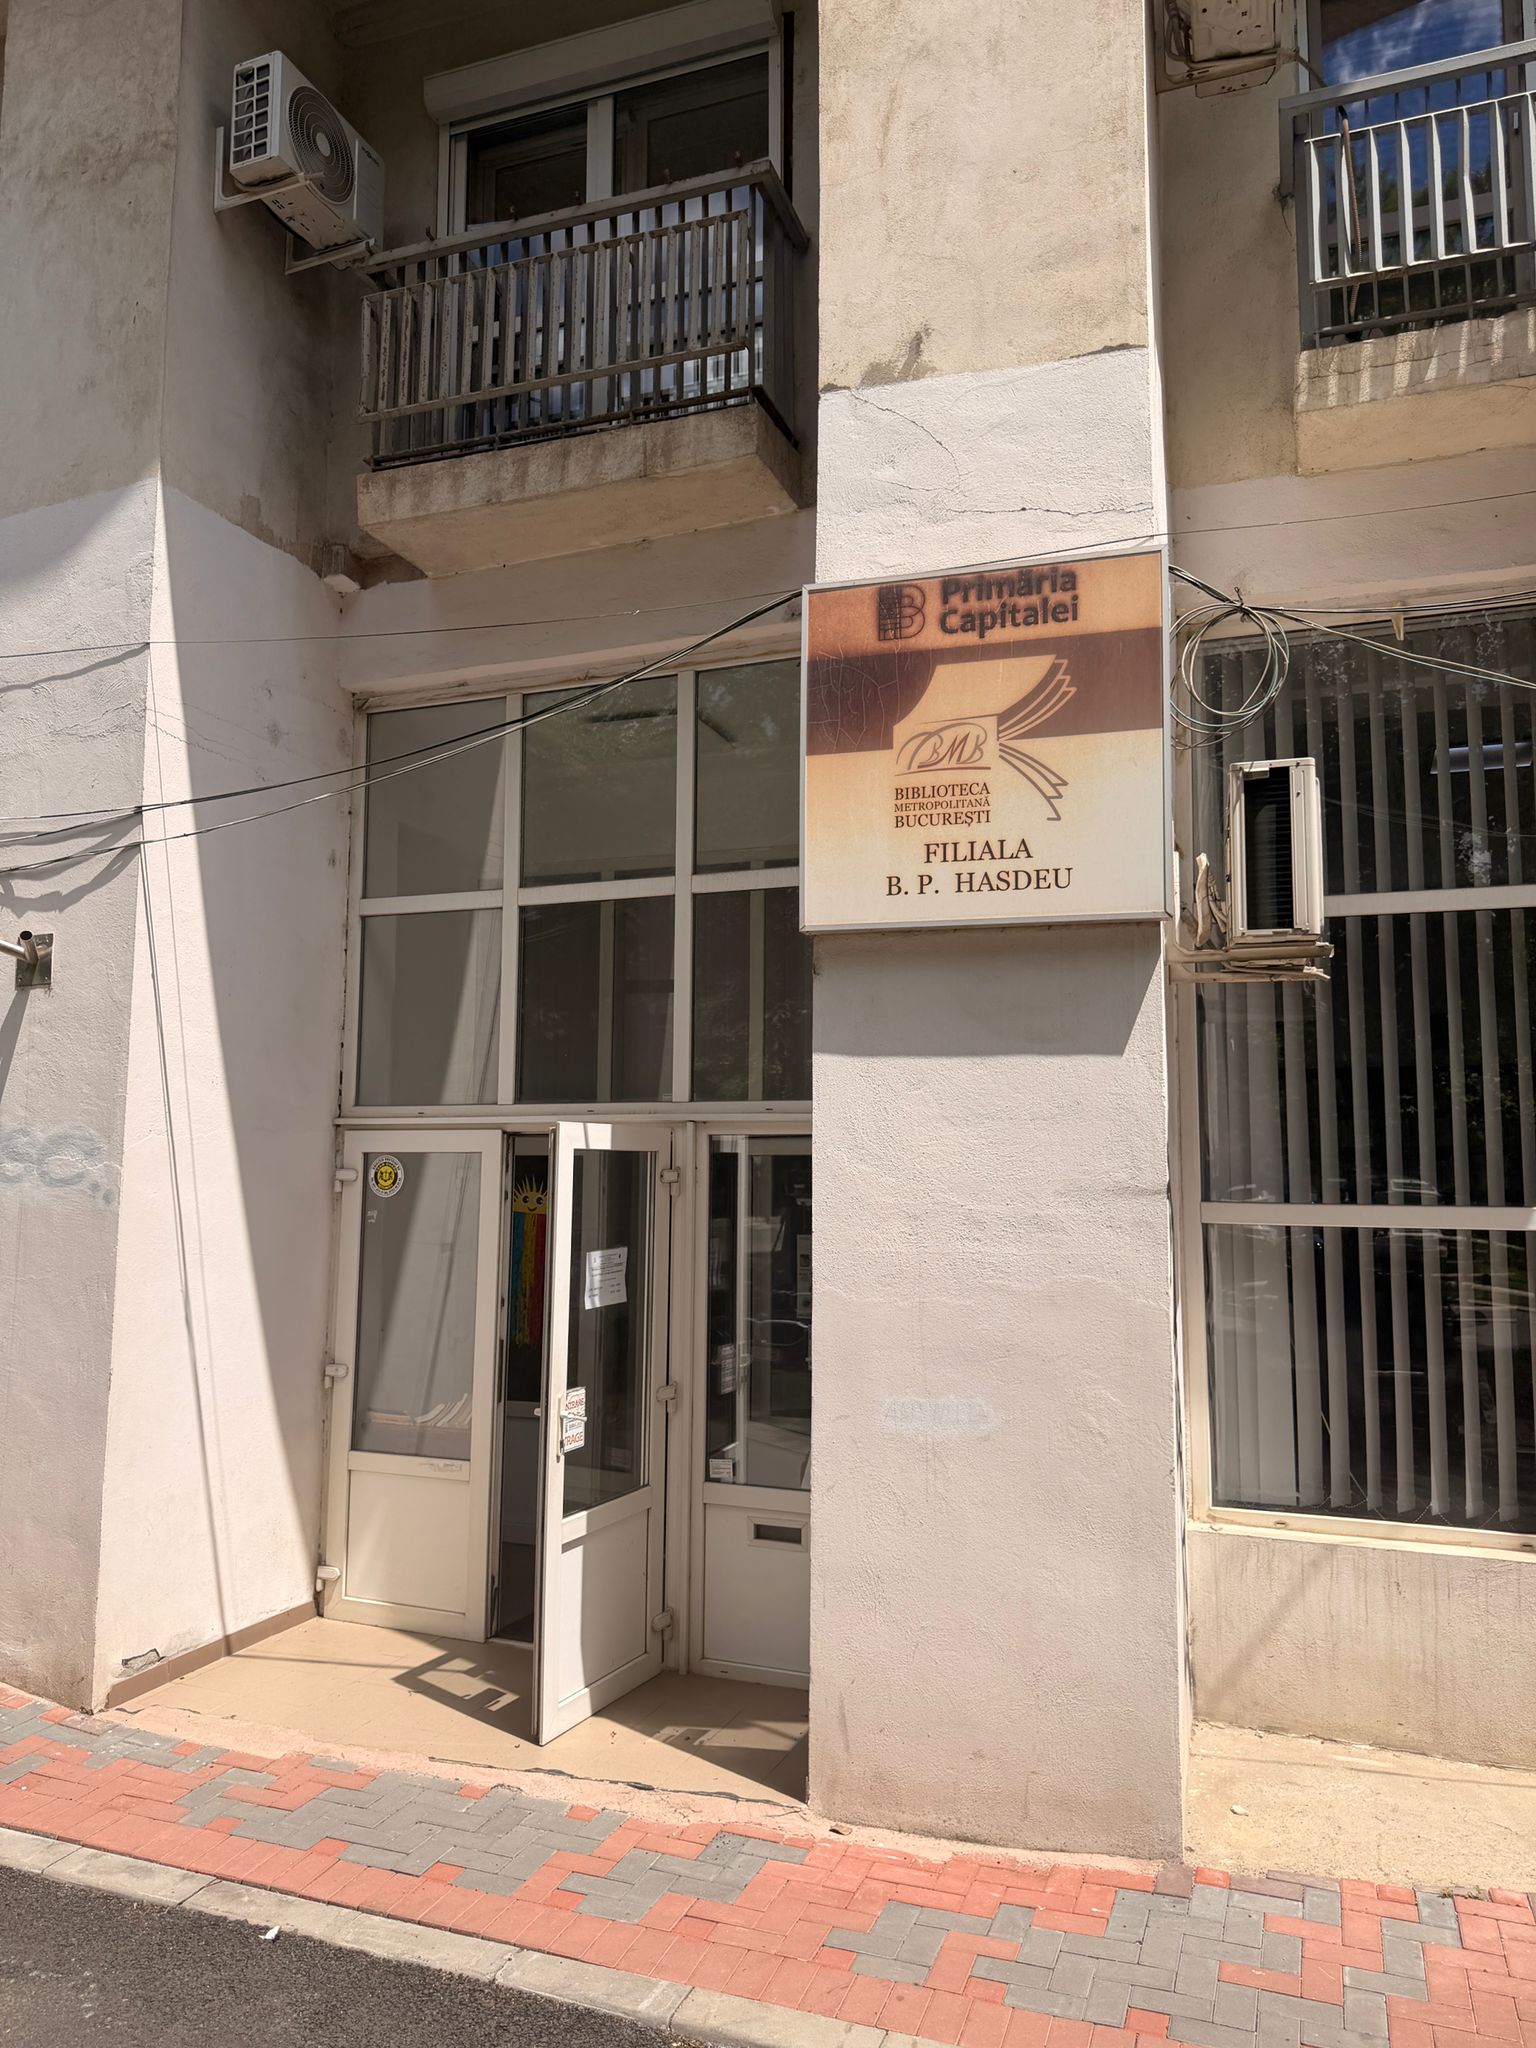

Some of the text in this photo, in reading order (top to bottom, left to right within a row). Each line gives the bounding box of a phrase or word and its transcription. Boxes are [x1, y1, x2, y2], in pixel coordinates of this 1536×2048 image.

[941, 566, 1077, 605] Primăria
[939, 595, 1079, 638] Capitalei
[893, 796, 991, 813] METROPOLITANĂ
[894, 782, 991, 801] BIBLIOTECA
[894, 810, 991, 829] BUCUREȘTI
[923, 838, 1034, 864] FILIALA
[885, 867, 1074, 897] B. P. HASDEU
